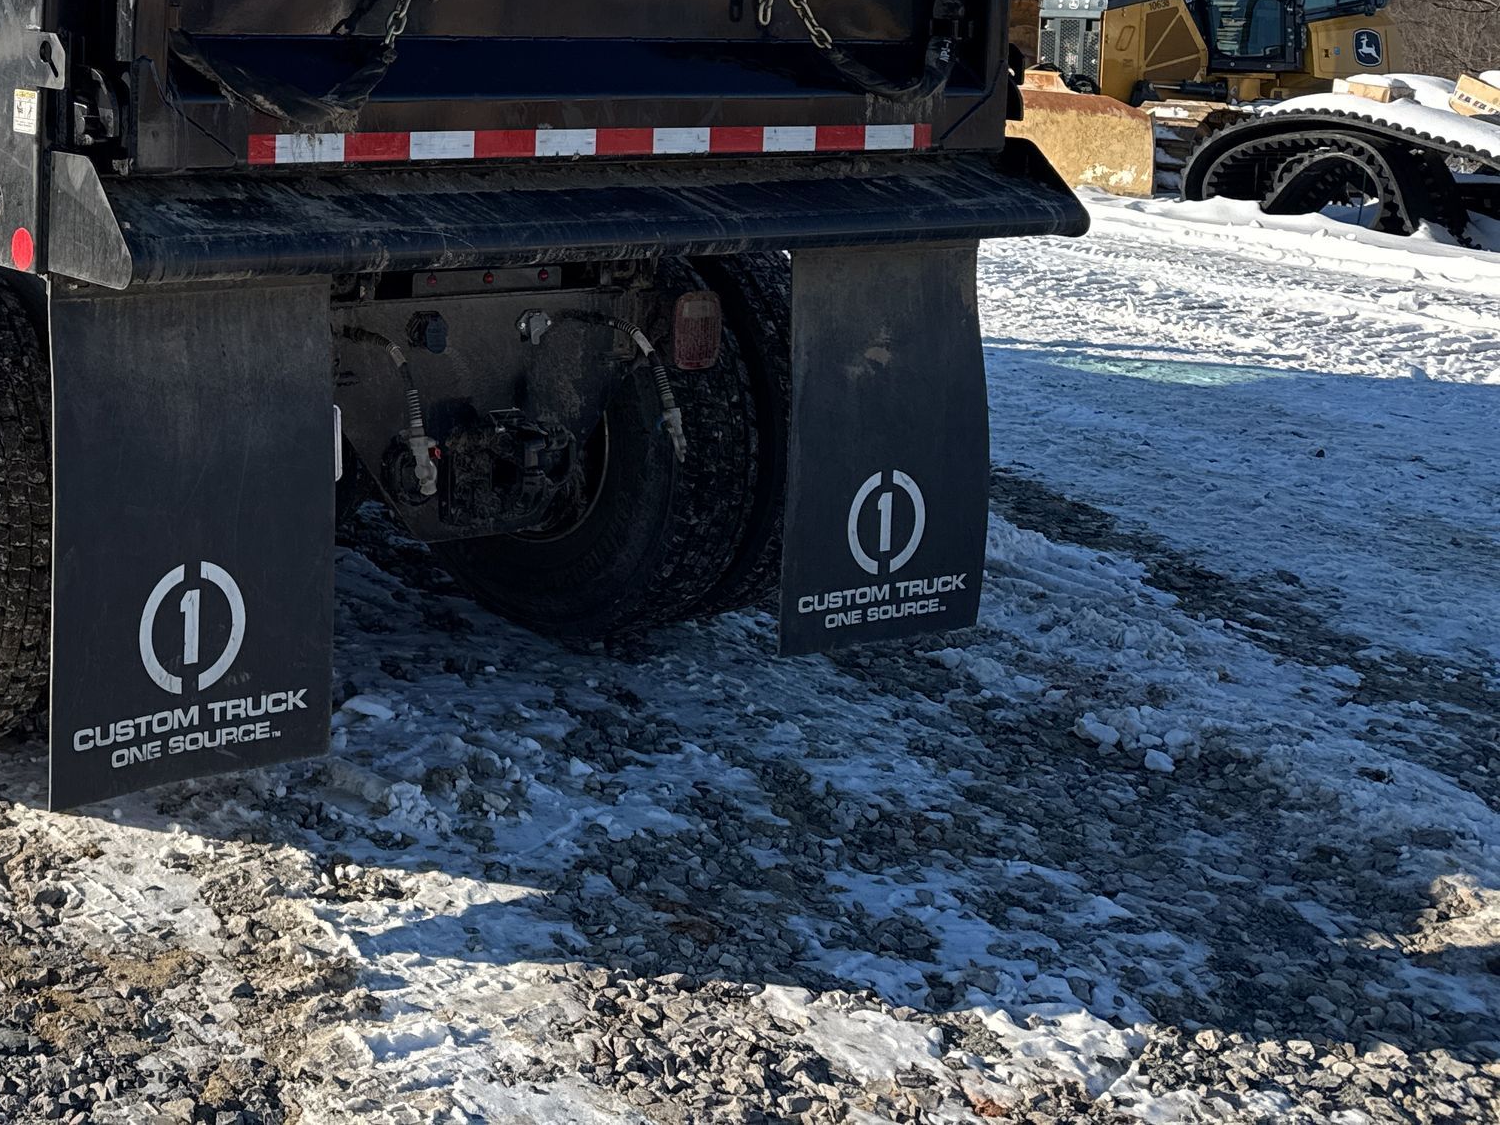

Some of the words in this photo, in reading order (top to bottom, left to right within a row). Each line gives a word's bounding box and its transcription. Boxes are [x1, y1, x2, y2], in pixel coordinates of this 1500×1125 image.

[797, 584, 890, 613] CUSTOM
[895, 573, 968, 598] TRUCK
[824, 610, 863, 629] ONE
[866, 598, 940, 622] SOURCE
[73, 705, 200, 752] CUSTOM
[207, 688, 308, 723] TRUCK
[111, 740, 162, 768] ONE
